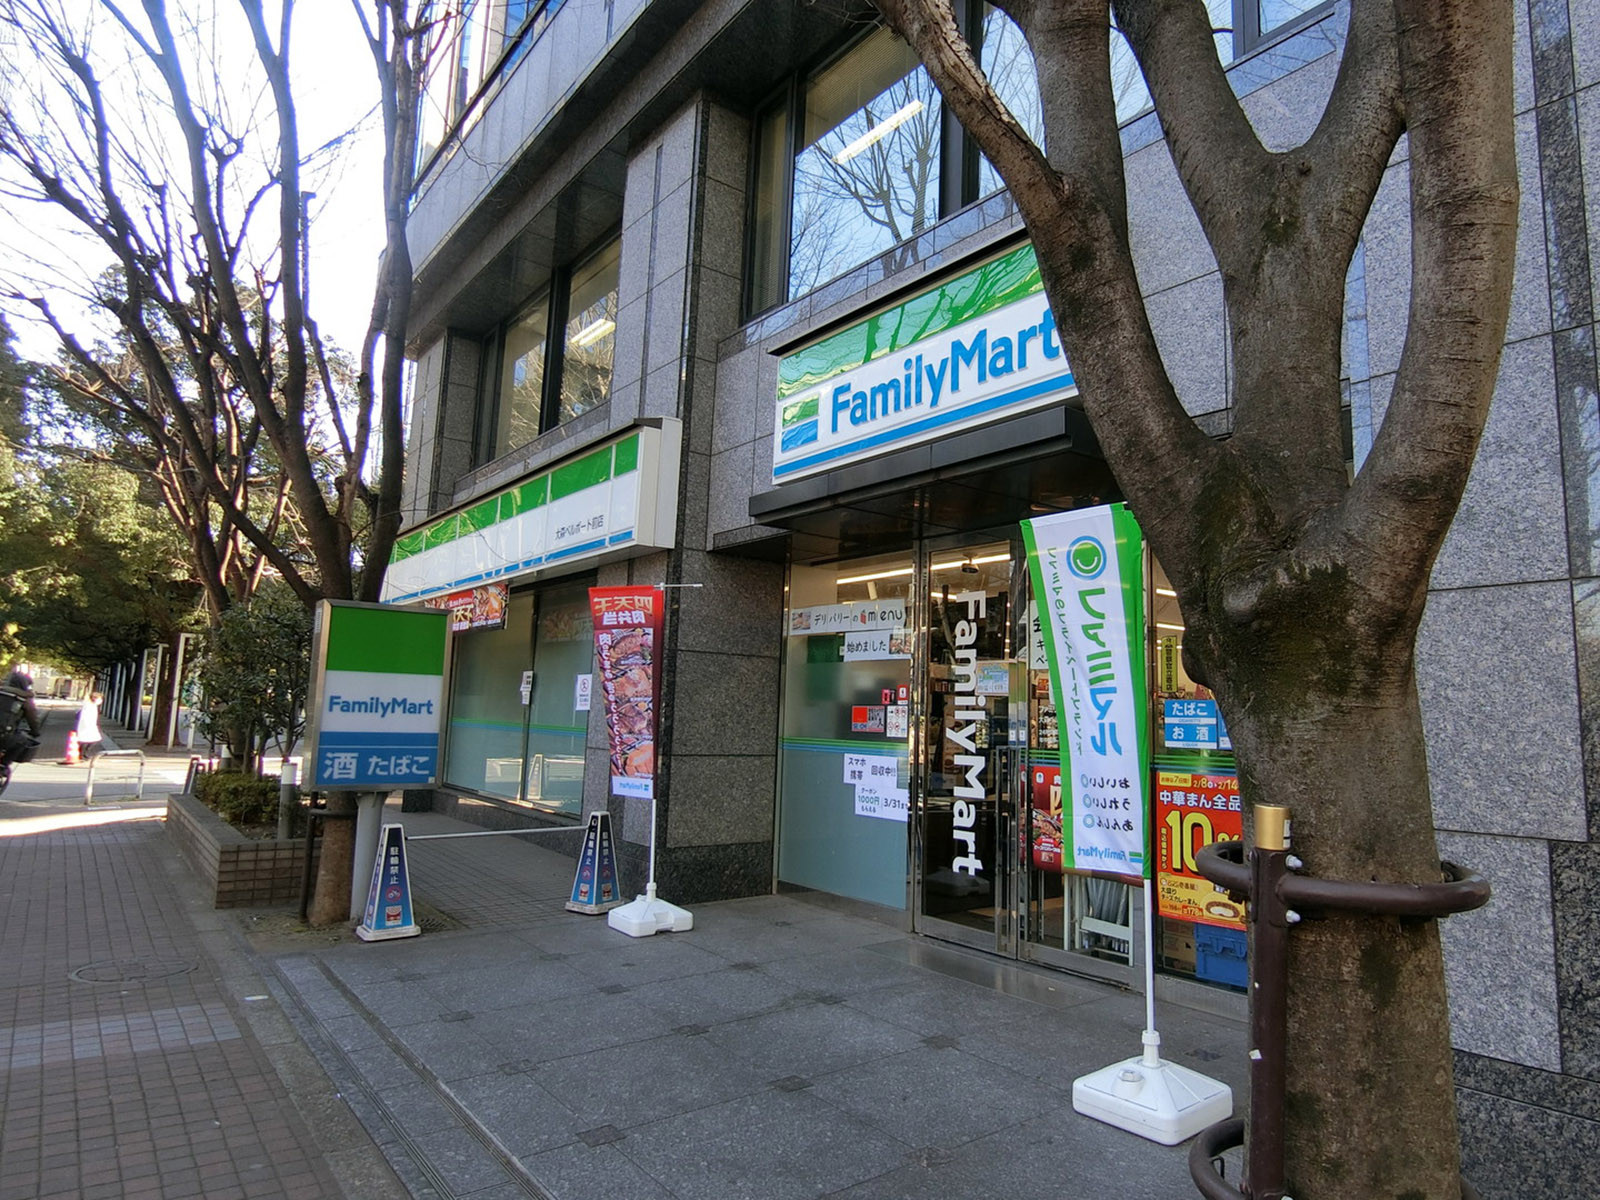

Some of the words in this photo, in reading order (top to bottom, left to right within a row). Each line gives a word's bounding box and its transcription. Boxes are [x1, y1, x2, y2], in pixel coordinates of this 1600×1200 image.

[831, 308, 1061, 434] FamilyMart
[846, 641, 887, 653] 始めました
[328, 695, 434, 719] FamilyMart
[1171, 701, 1209, 716] たばこ
[945, 590, 986, 877] FamilyMart
[323, 752, 359, 779] 酒
[367, 754, 430, 775] たばこ
[848, 757, 867, 767] スマホ
[858, 795, 880, 806] 1000円
[1160, 789, 1241, 811] 中華まん全品
[1165, 810, 1240, 872] 10
